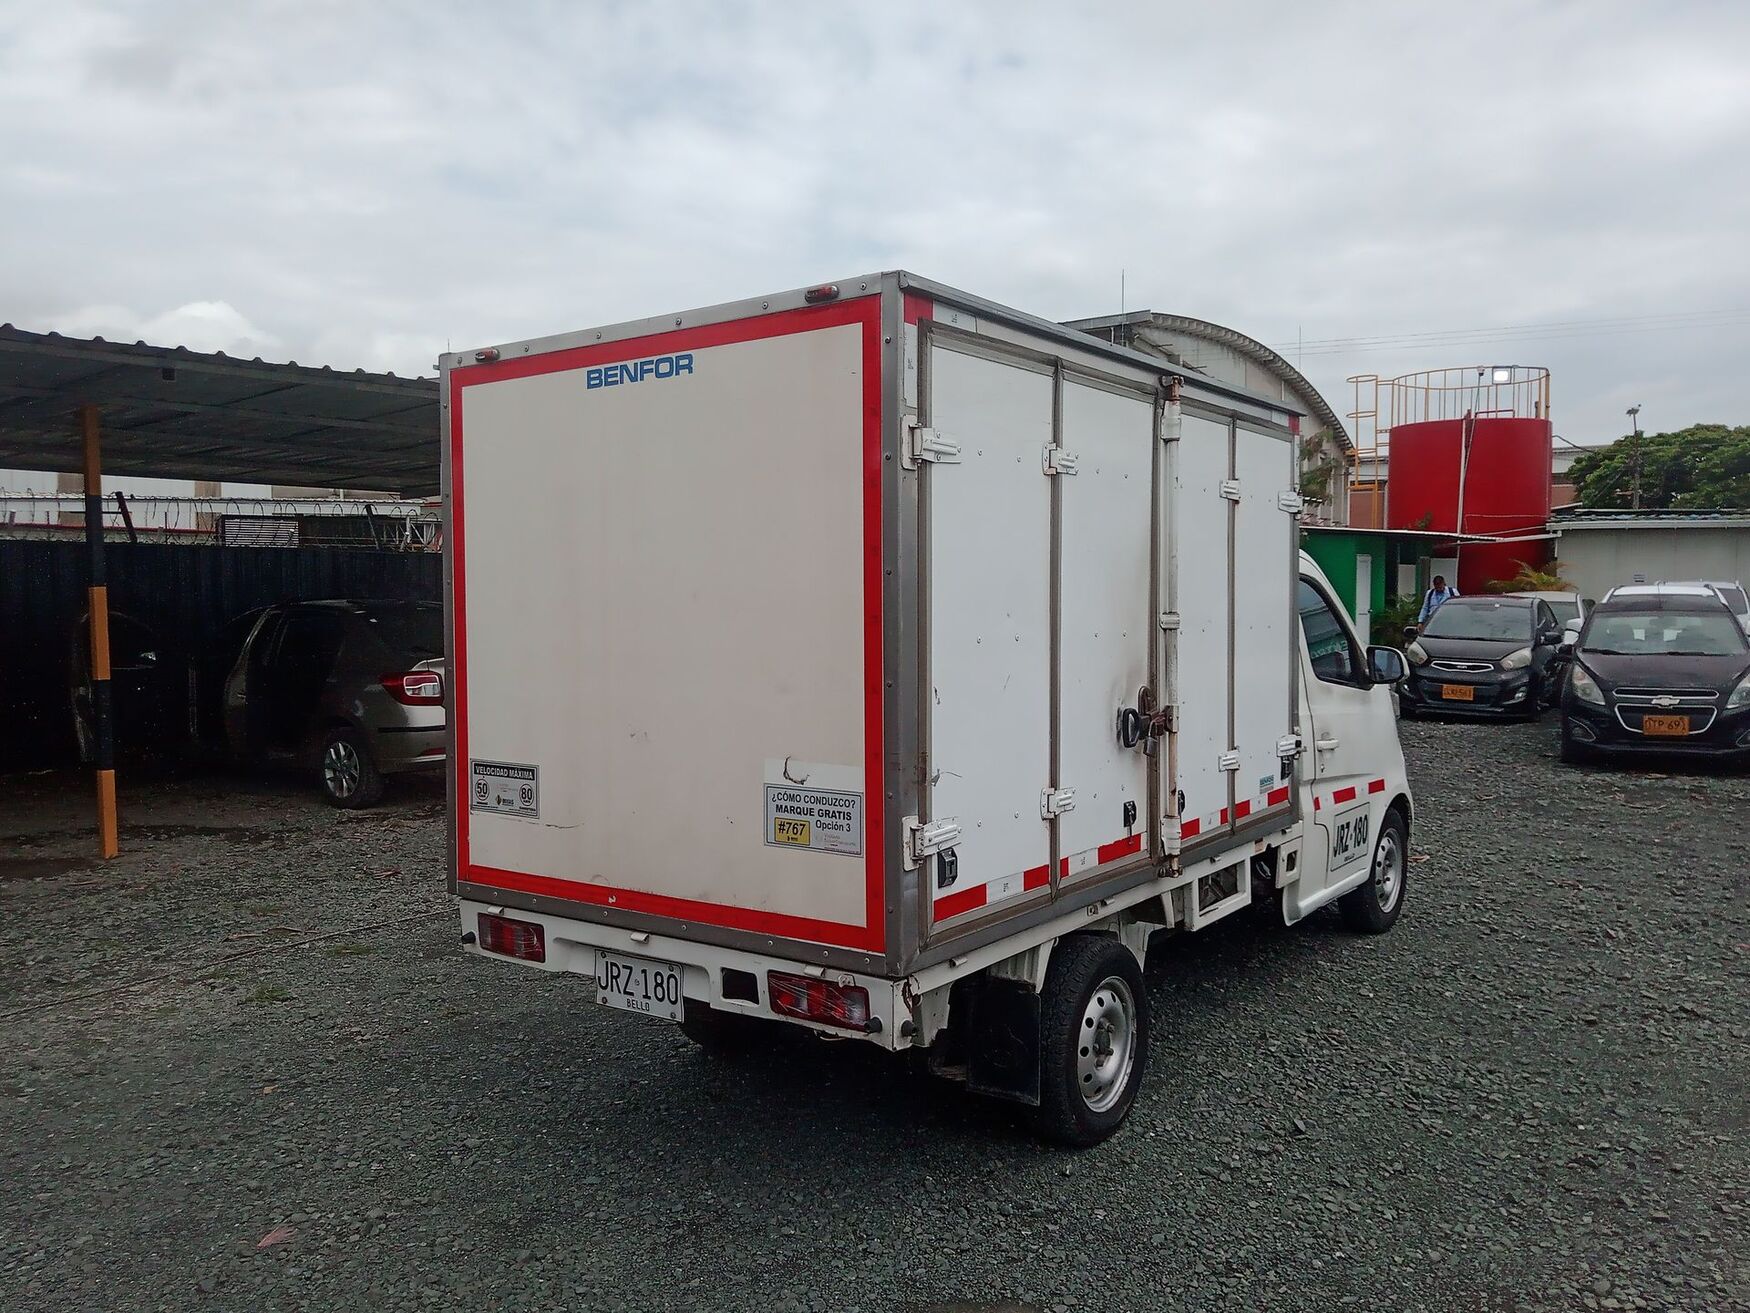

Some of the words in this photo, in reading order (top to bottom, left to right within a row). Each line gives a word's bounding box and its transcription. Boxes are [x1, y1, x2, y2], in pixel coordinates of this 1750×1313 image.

[586, 353, 694, 390] BENFOR
[475, 765, 508, 777] VELOCIDAD
[509, 767, 534, 780] MÁXIMA
[477, 782, 488, 795] 50
[521, 787, 533, 801] 80
[771, 791, 802, 803] ¿CÓMO
[803, 794, 856, 809] CONDUZCO?
[775, 804, 815, 817] MARQUE
[817, 808, 852, 821] GRATIS
[778, 820, 807, 836] #767
[815, 819, 844, 832] Opción
[845, 823, 851, 832] 3
[597, 960, 635, 997] JRZ
[640, 968, 679, 1006] 180
[626, 998, 650, 1012] BELLO
